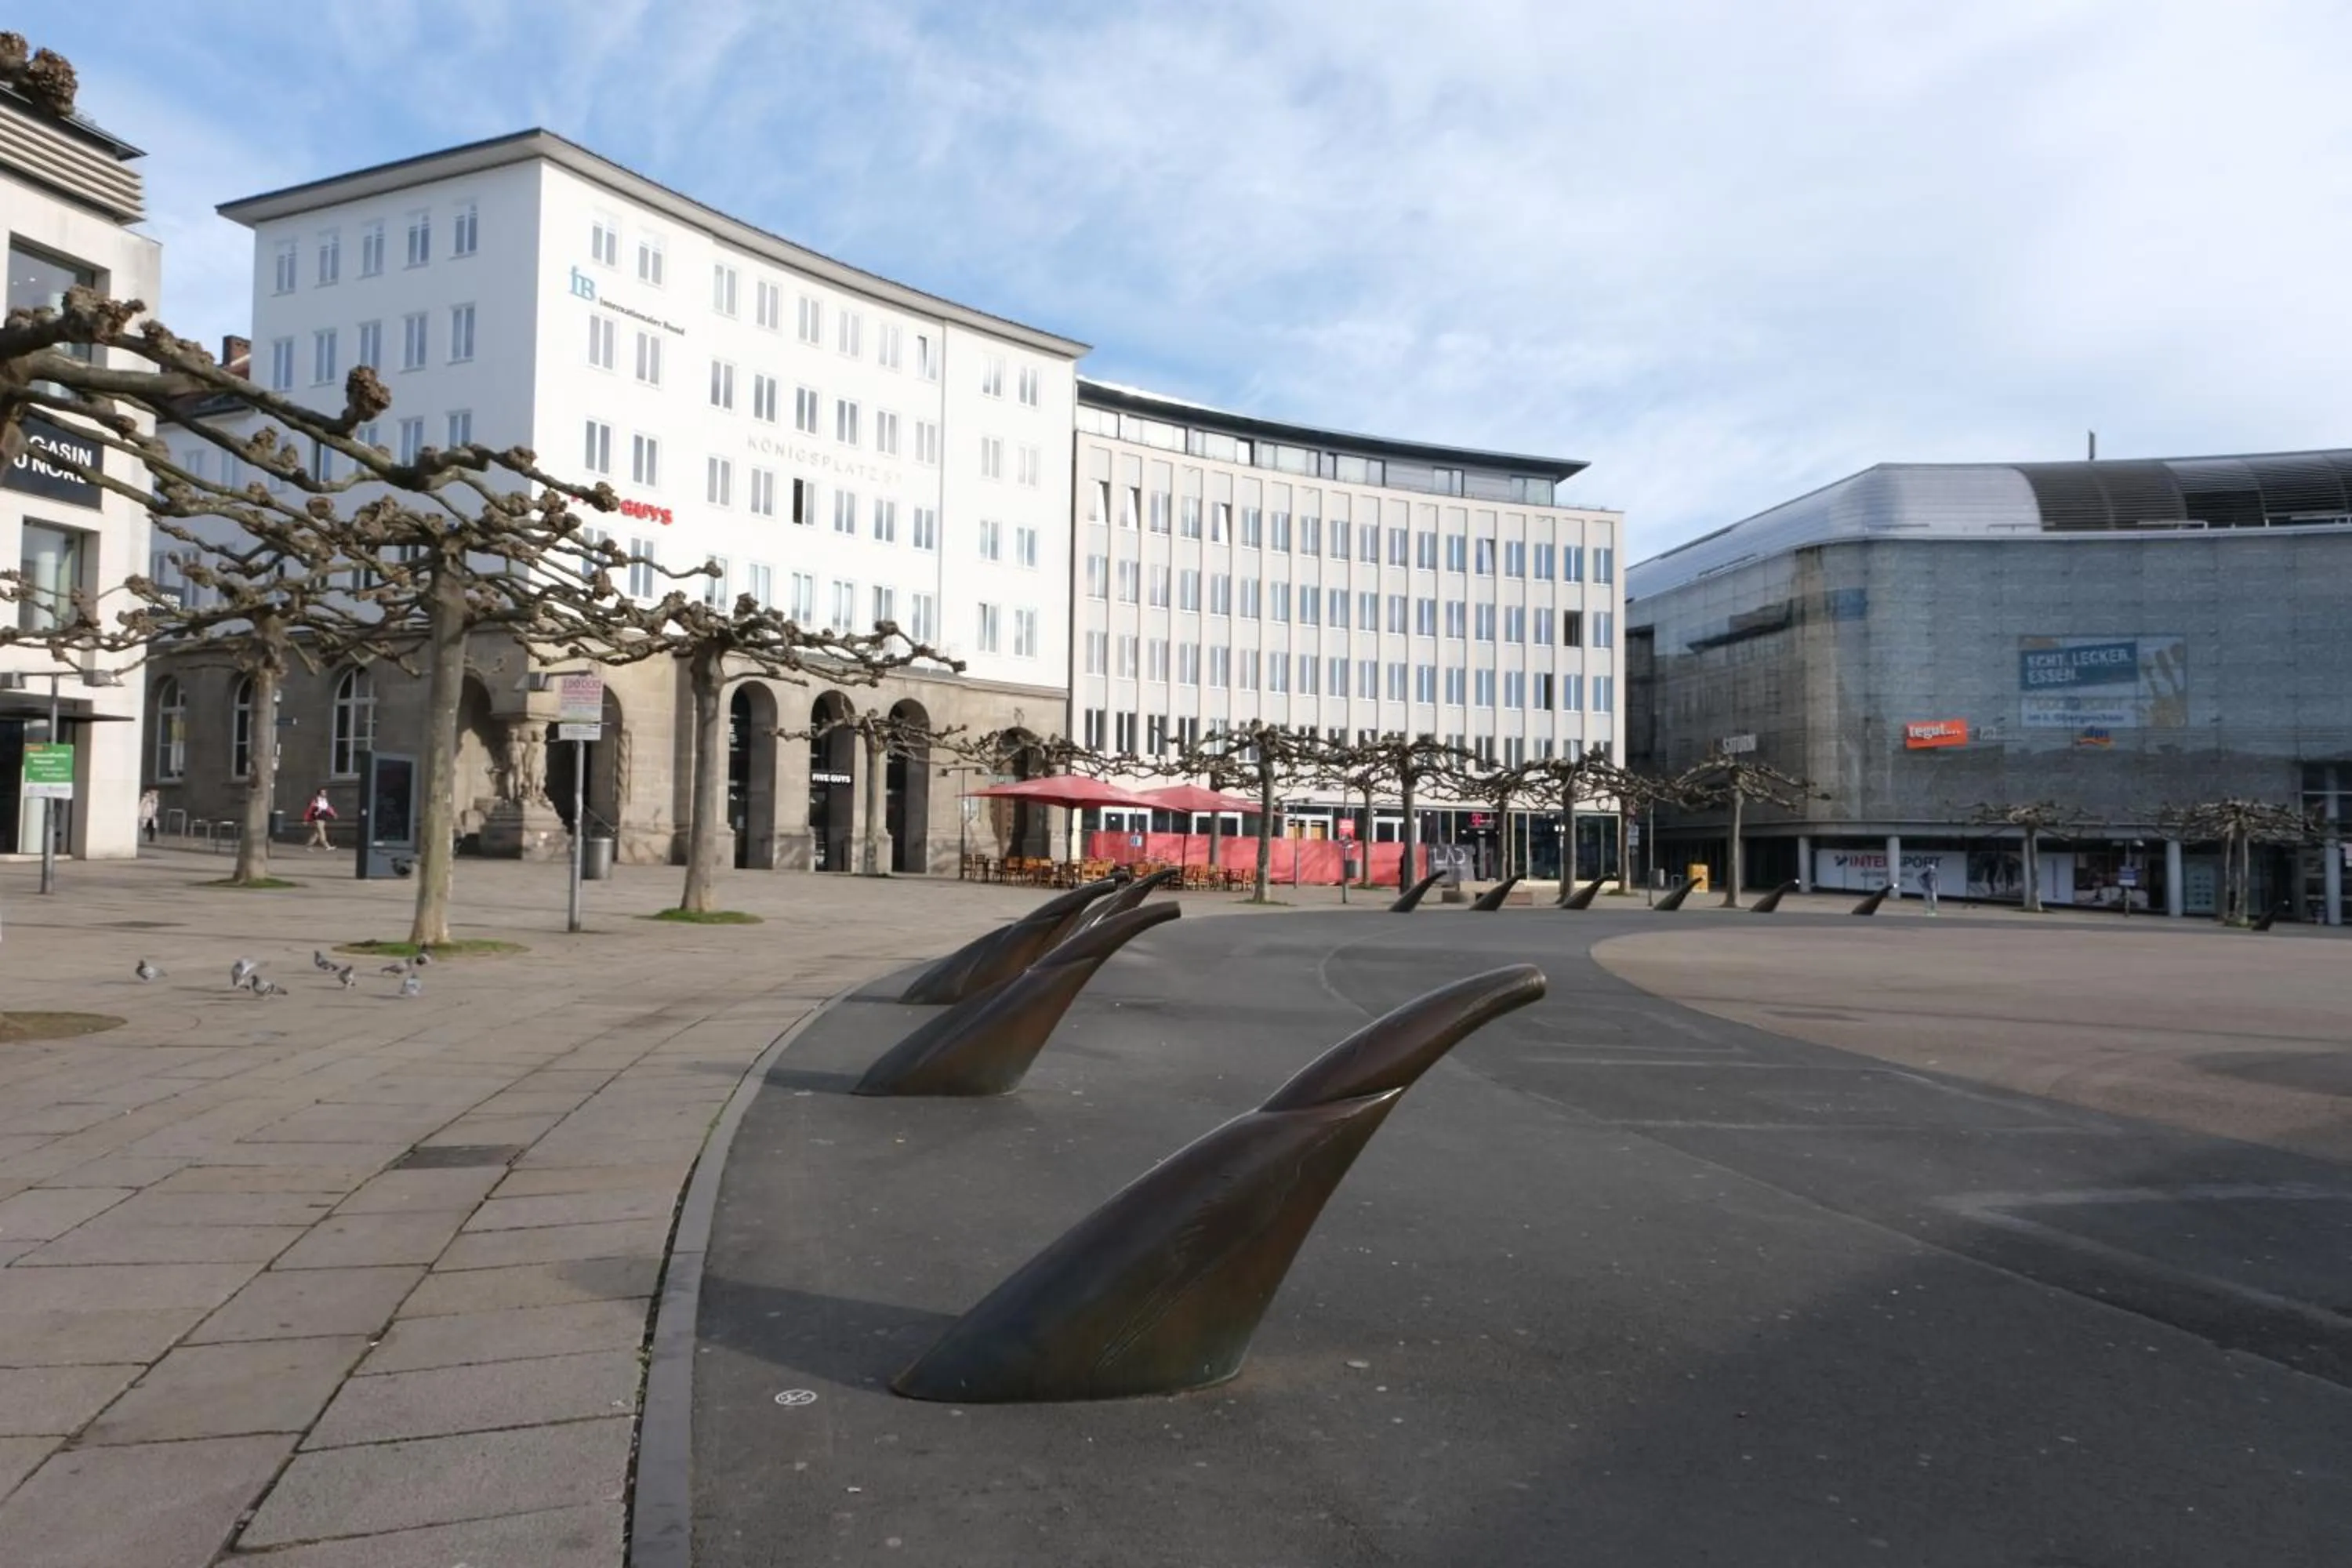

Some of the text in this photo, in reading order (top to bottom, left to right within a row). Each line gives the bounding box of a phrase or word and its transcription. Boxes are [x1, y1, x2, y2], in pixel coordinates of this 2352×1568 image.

[599, 296, 686, 337] Internationaler Bund
[620, 499, 673, 526] GUYS
[812, 773, 851, 783] FIVE GUYS
